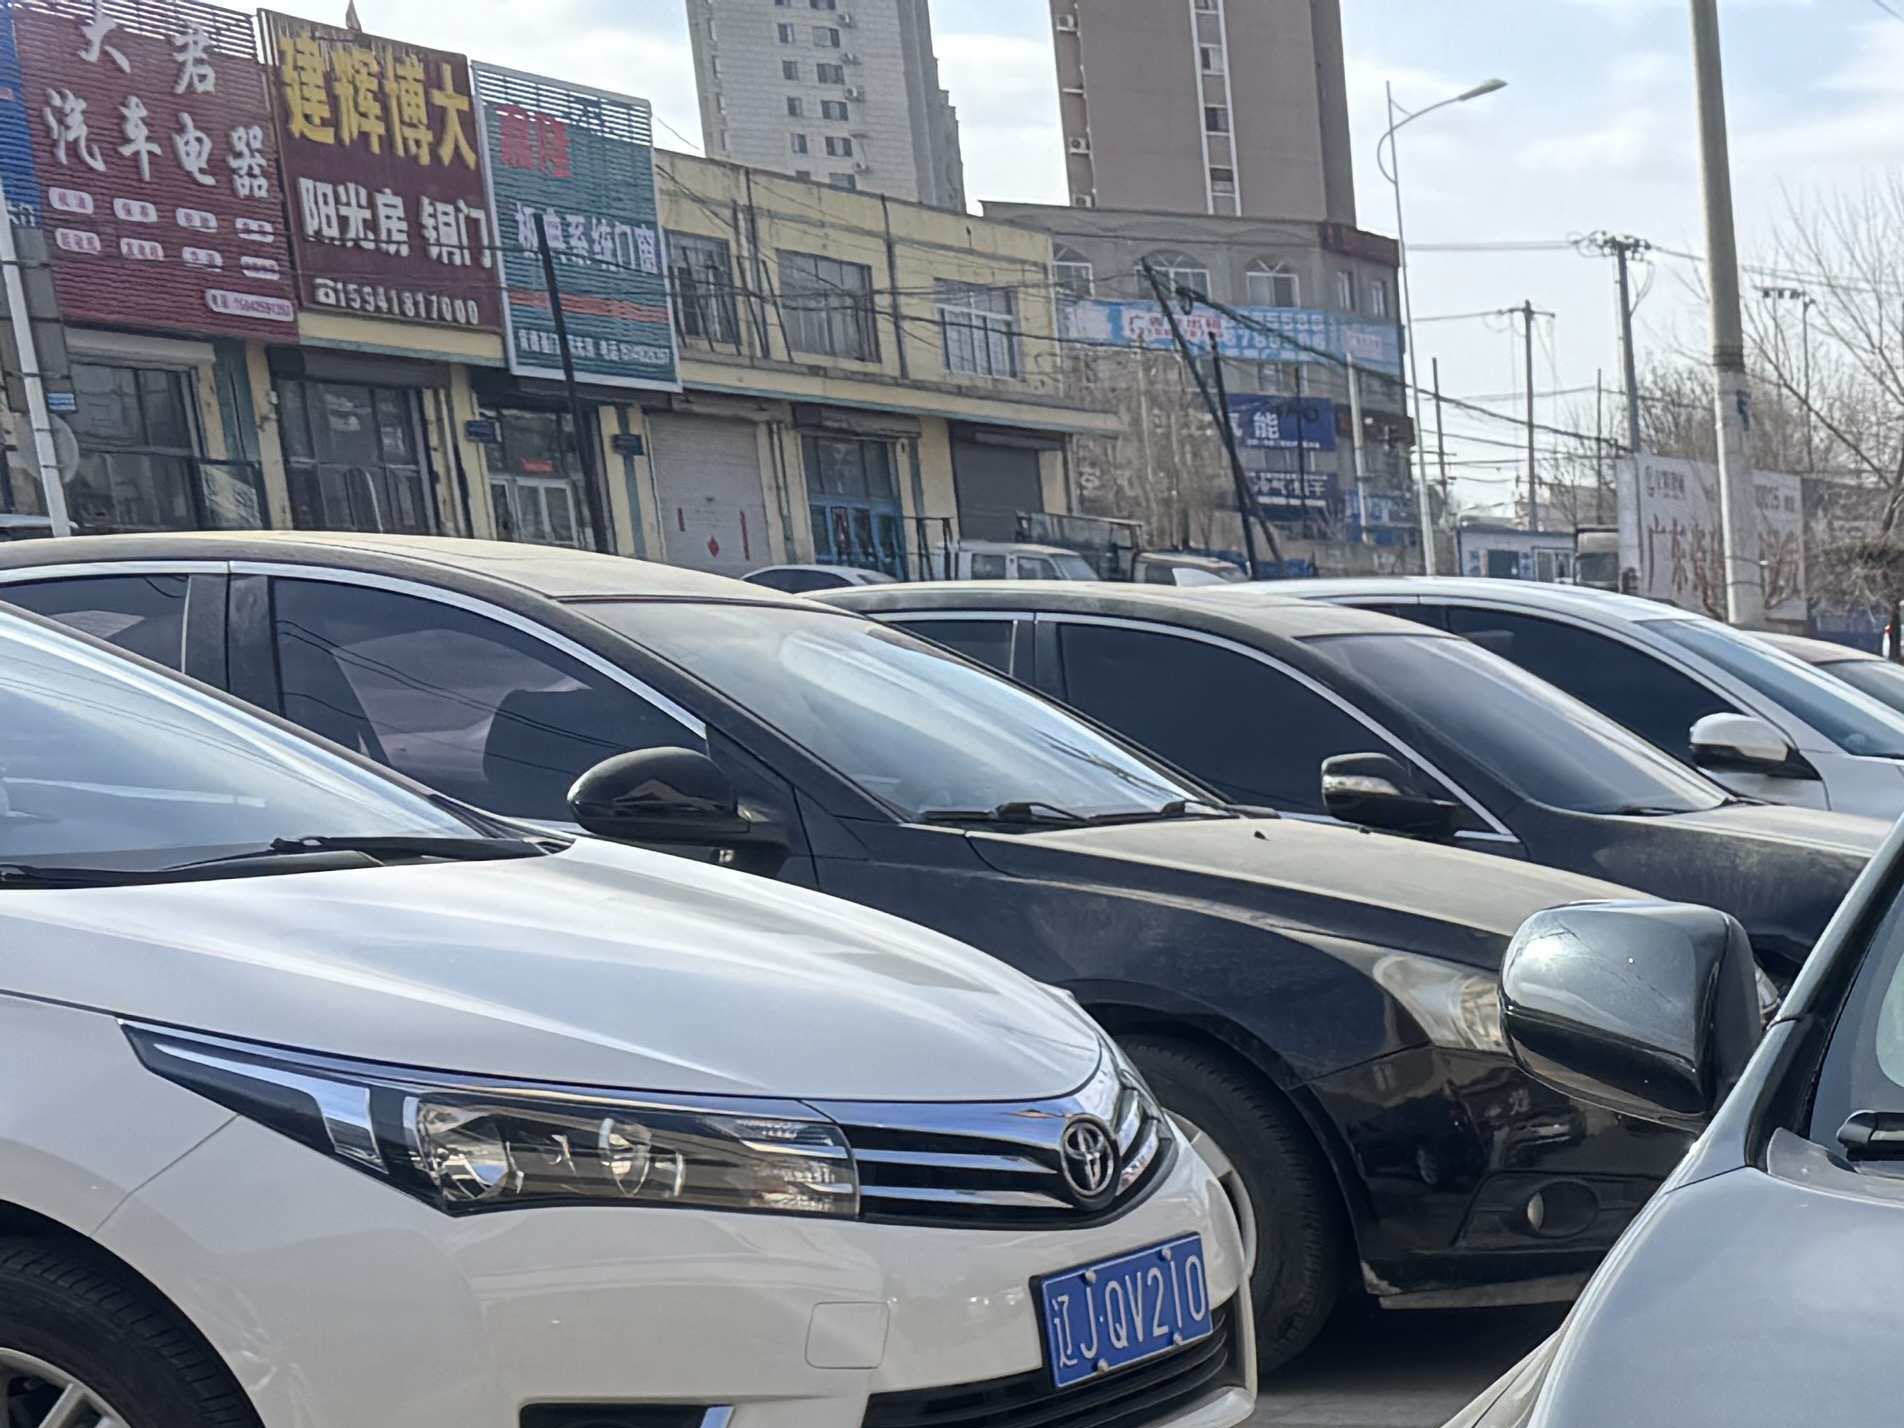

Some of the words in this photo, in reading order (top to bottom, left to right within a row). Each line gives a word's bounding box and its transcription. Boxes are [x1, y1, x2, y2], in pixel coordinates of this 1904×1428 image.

[42, 87, 269, 199] 汽车电器
[298, 176, 410, 258] 阳光房
[336, 281, 479, 325] 15941817000
